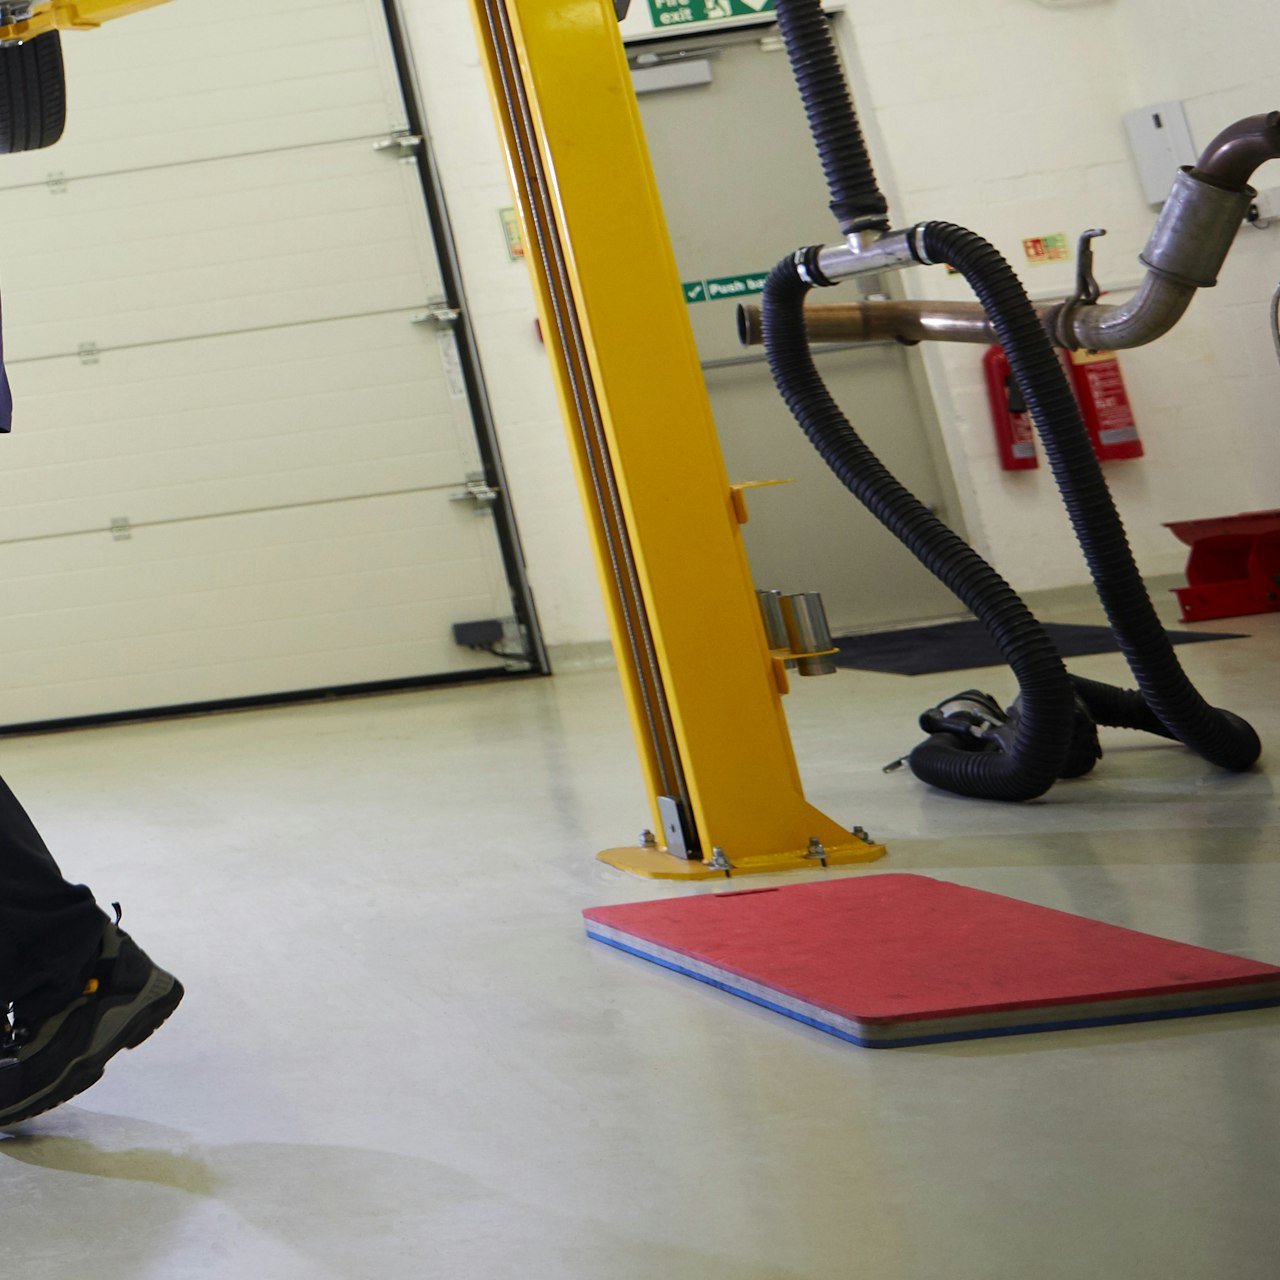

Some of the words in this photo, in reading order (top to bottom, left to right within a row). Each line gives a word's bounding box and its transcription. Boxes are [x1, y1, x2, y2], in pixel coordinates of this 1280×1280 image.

[659, 7, 693, 24] exit
[708, 280, 747, 296] Push
[746, 278, 766, 291] ba
